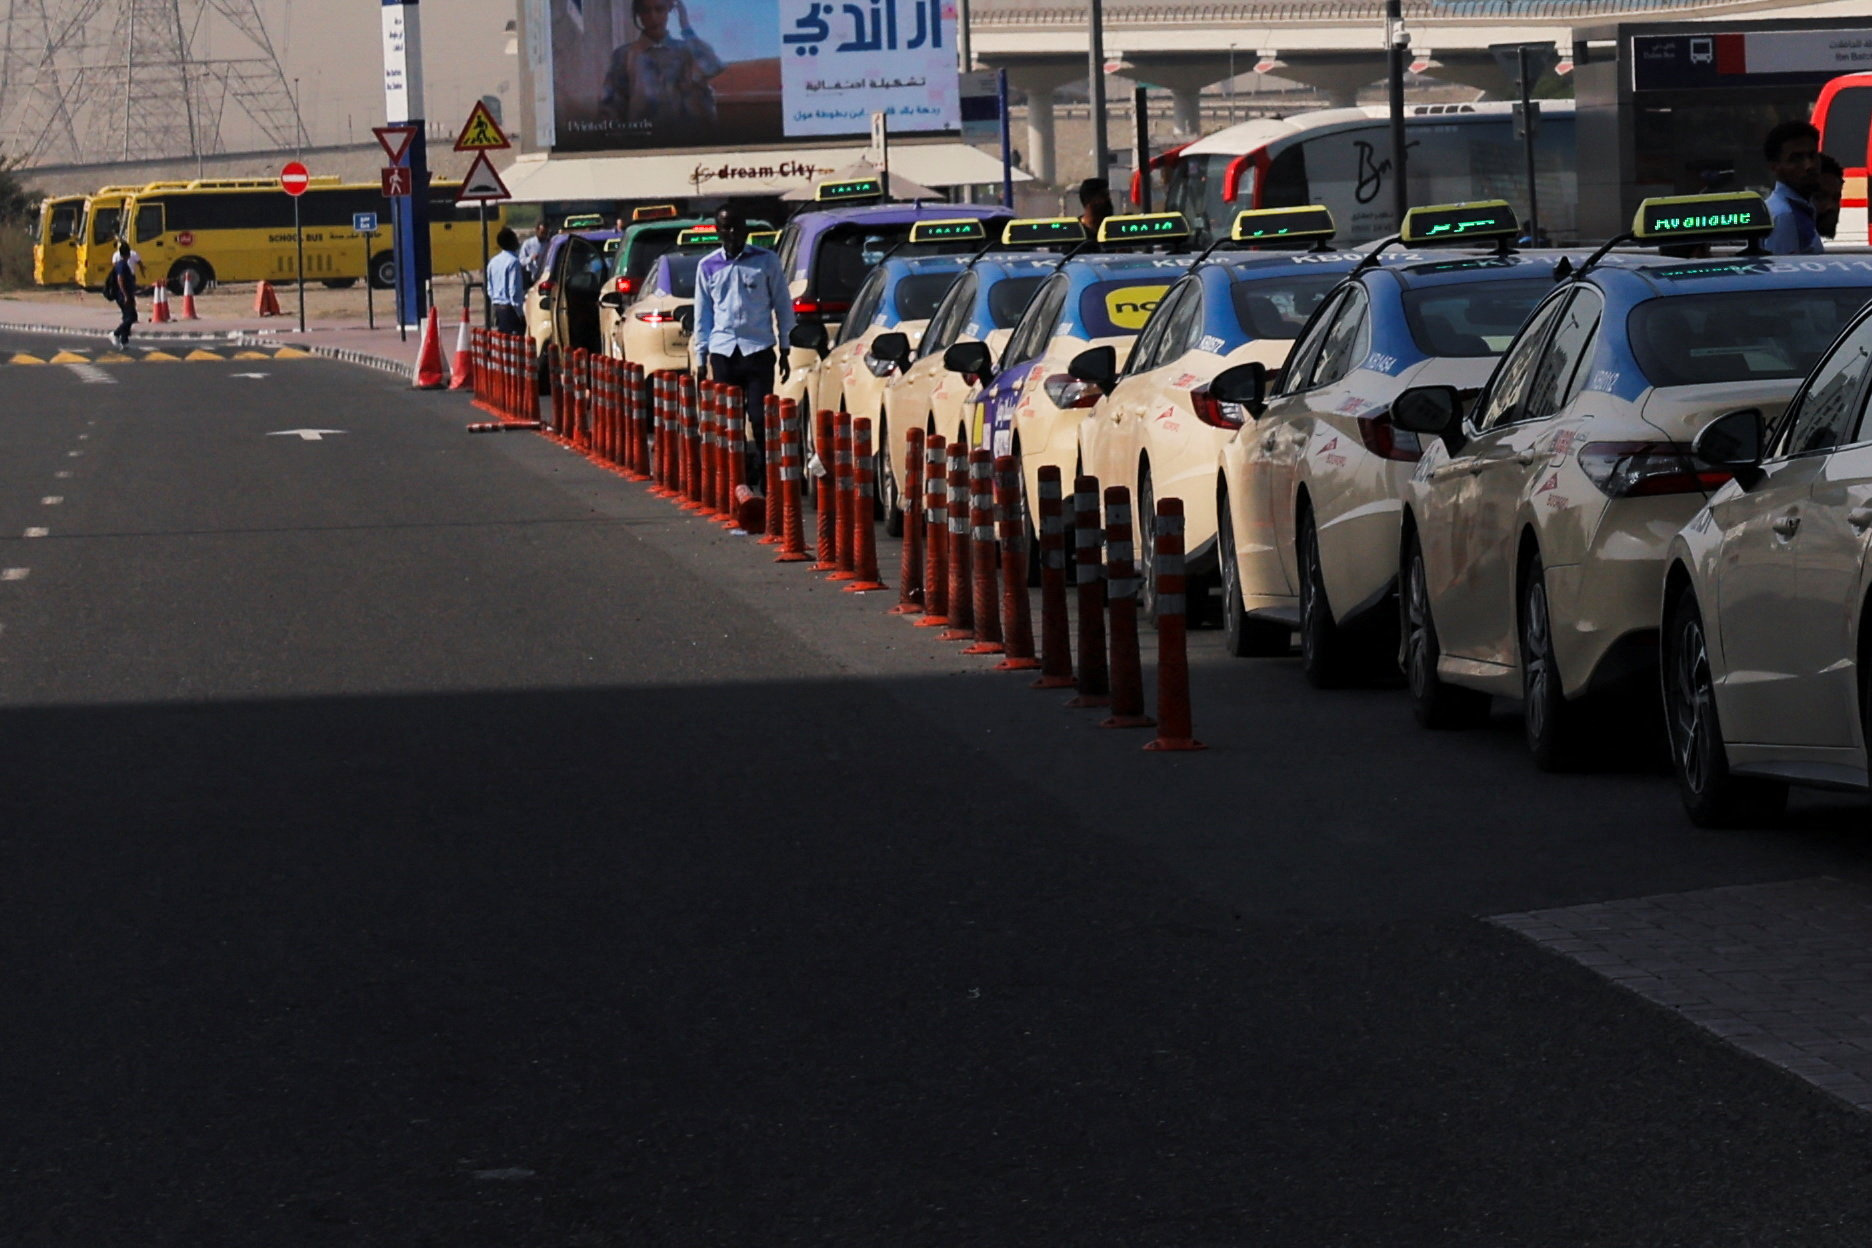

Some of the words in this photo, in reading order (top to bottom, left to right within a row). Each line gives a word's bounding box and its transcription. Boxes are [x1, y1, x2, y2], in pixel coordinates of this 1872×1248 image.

[718, 164, 773, 179] dream
[779, 160, 815, 183] City
[1115, 301, 1159, 314] no
